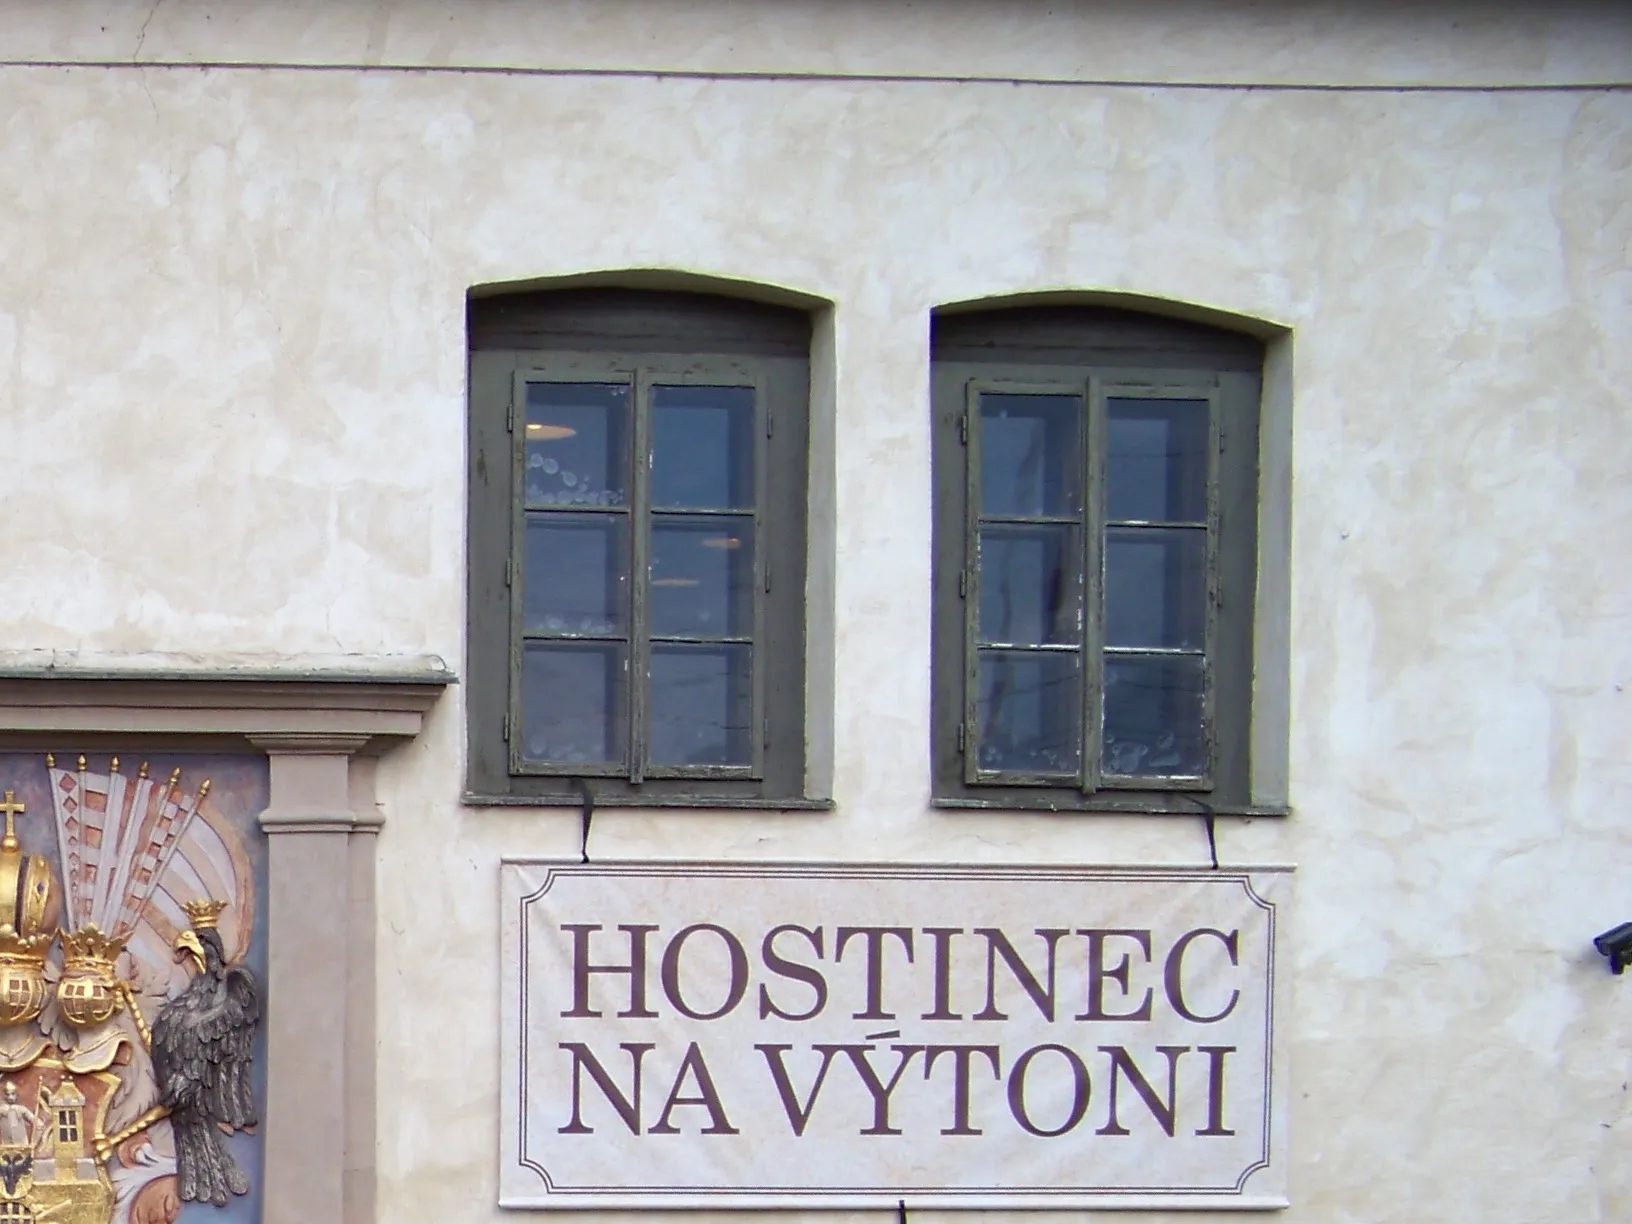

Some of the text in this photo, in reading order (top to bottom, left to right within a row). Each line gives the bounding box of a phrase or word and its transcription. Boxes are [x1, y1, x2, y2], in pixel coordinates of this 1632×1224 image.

[561, 924, 1239, 1023] HOSTINEC
[558, 1031, 1236, 1137] NA VÝTONI
